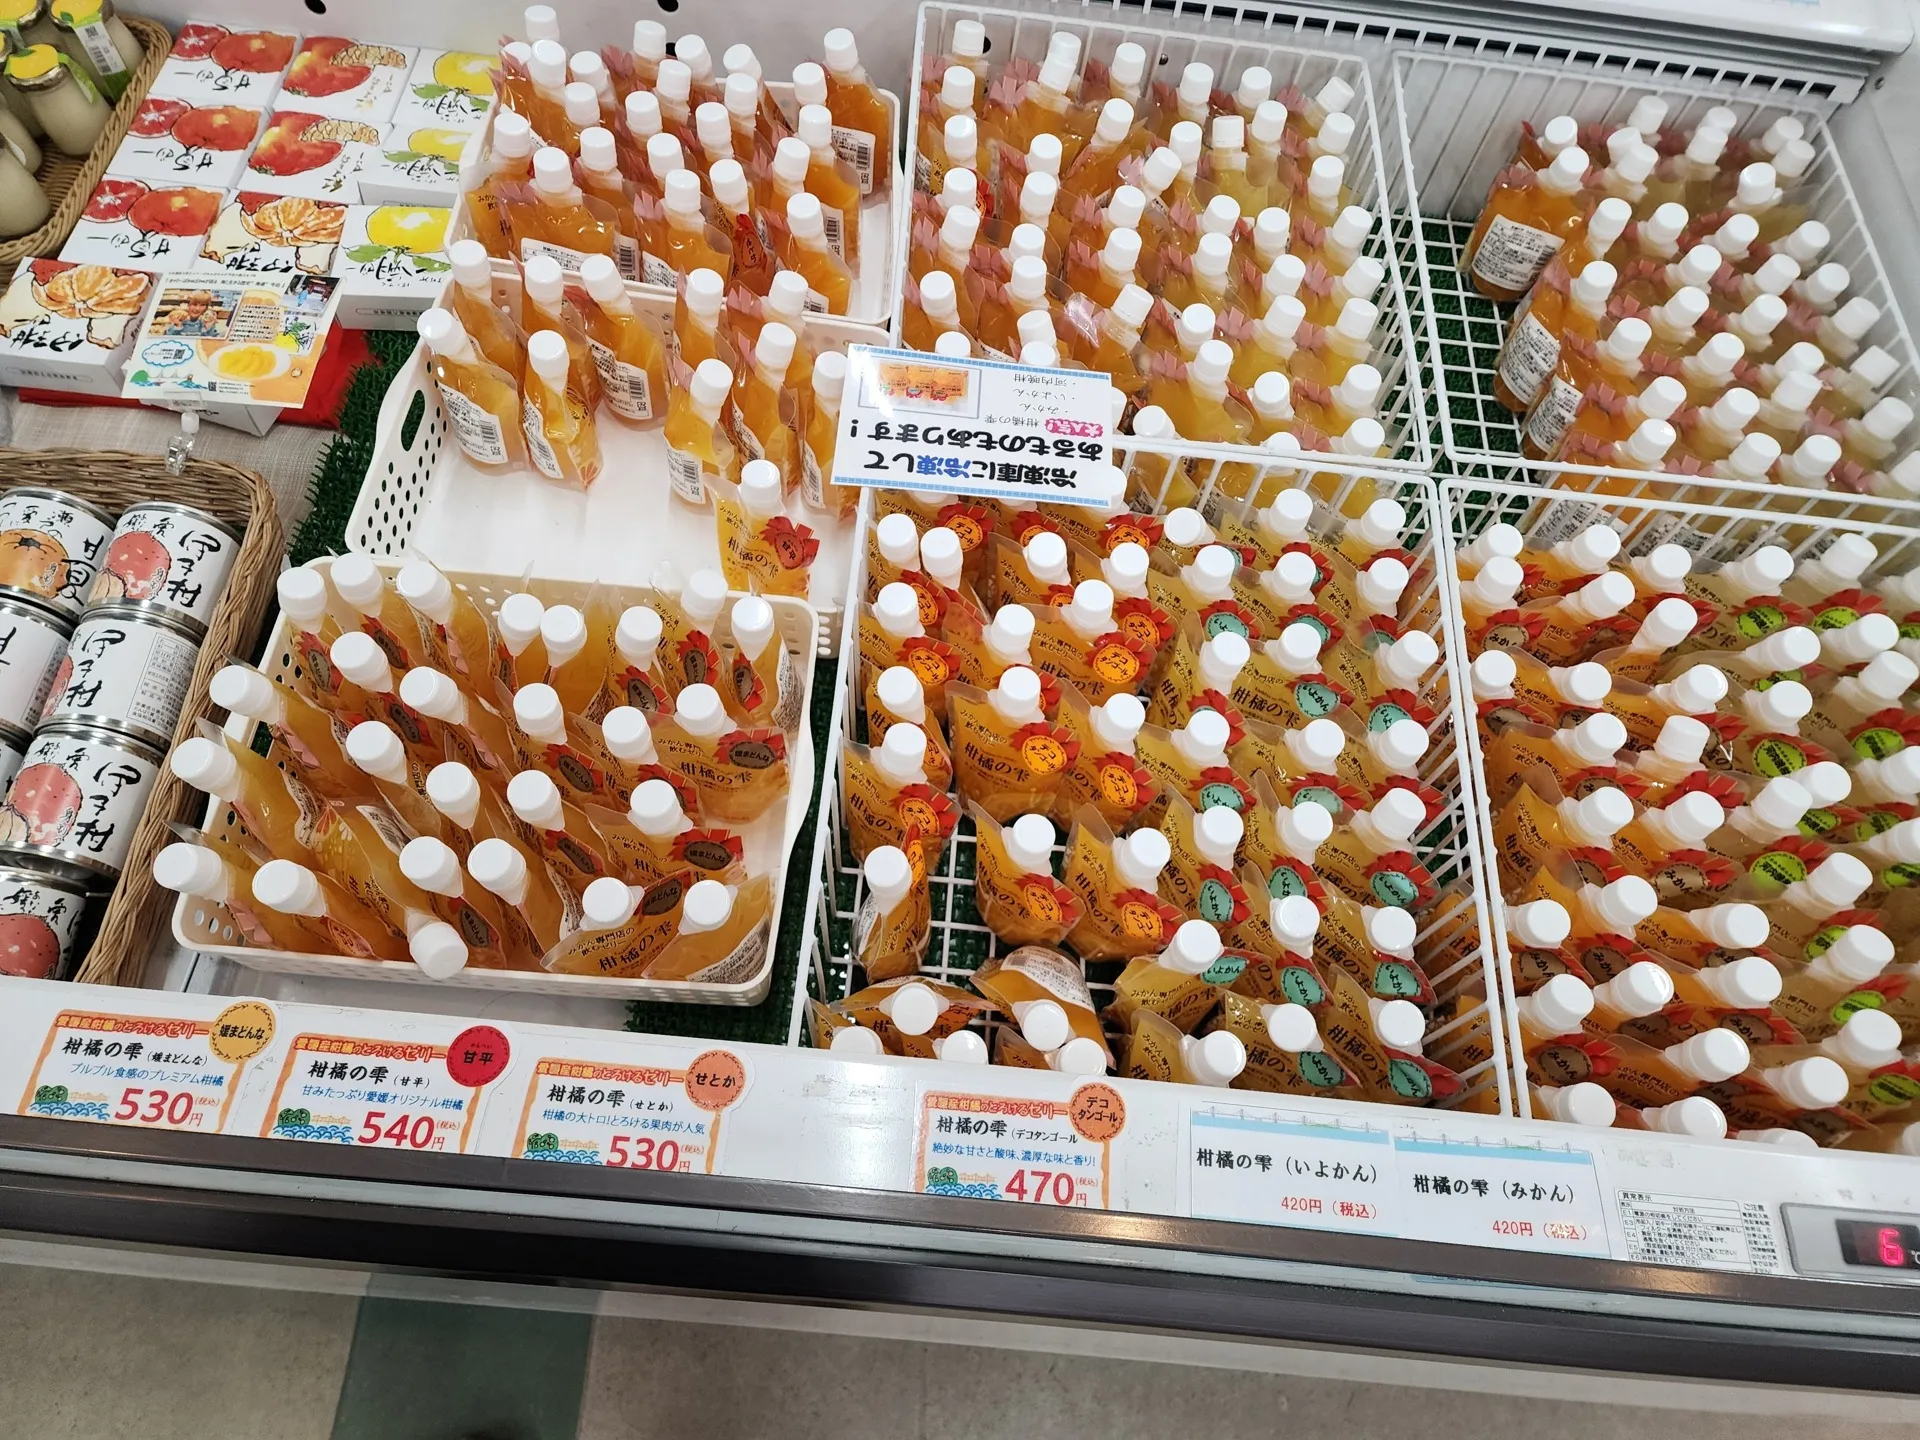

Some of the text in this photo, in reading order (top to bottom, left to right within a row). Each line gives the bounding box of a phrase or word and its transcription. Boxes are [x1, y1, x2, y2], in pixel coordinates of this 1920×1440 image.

[864, 451, 1077, 489] 冷凍庫に冷凍して
[1232, 686, 1300, 727] 柑橘の雫
[1302, 685, 1329, 712] いよかん
[1206, 963, 1242, 976] いよかん
[62, 1037, 143, 1060] 柑橘の雫
[463, 1050, 494, 1065] 甘平
[307, 1060, 389, 1085] 柑橘の雫
[695, 1072, 736, 1087] せとか
[547, 1084, 626, 1109] 柑橘の雫
[1086, 1096, 1109, 1109] デコ
[936, 1115, 1008, 1138] 柑橘の雫
[1878, 1228, 1904, 1266] 6
